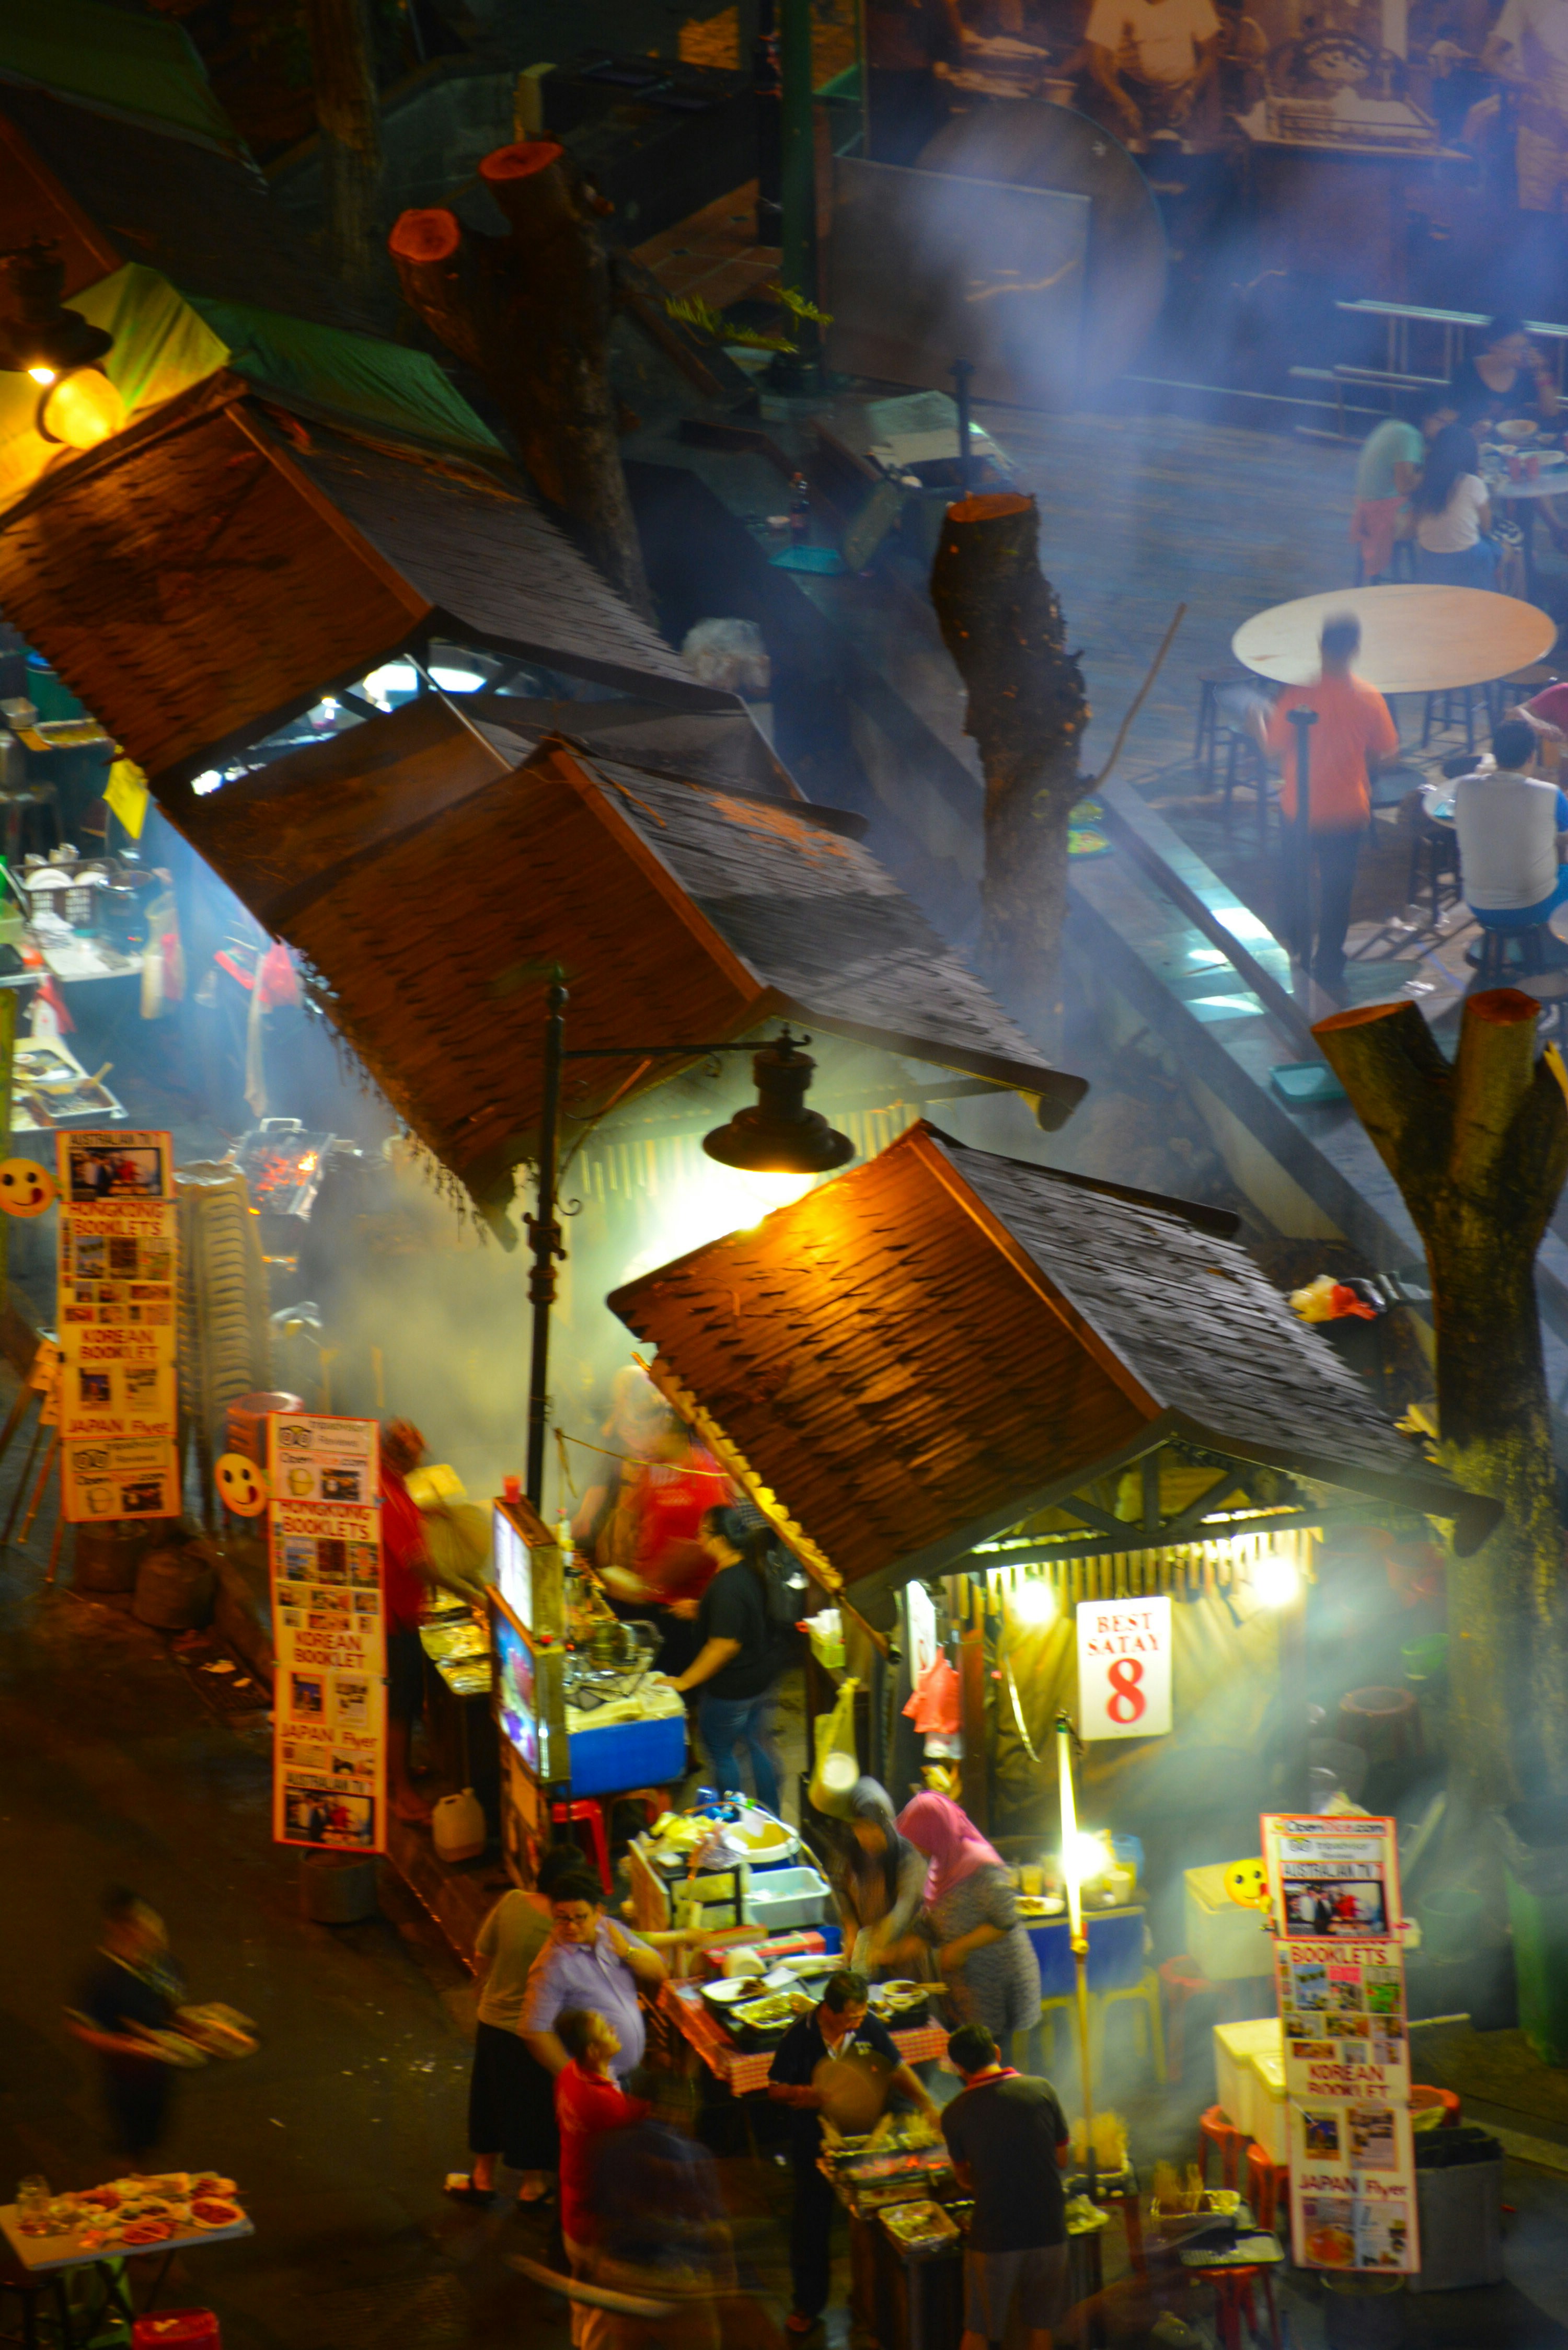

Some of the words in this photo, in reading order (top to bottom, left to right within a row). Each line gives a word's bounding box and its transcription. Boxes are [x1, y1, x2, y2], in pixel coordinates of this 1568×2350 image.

[70, 1203, 164, 1218] HONGKONG
[74, 1218, 162, 1237] BOOKLETS
[82, 1329, 154, 1344] KOREAN
[79, 1343, 159, 1359] BOOKLET
[67, 1419, 124, 1433] JAPAN
[132, 1420, 169, 1435] Flyer
[279, 1502, 371, 1522] HONGKONG
[282, 1515, 370, 1540] BOOKLETS
[1097, 1612, 1153, 1633] BEST
[294, 1630, 363, 1652] KOREAN
[1087, 1633, 1162, 1656] SATAY
[293, 1648, 367, 1669] BOOKLET
[1106, 1657, 1147, 1724] 8
[280, 1723, 335, 1743] JAPAN
[341, 1731, 377, 1749] Flyer
[1284, 1863, 1354, 1877] AUSTRALIAN
[1290, 1945, 1388, 1965] BOOKLETS
[1309, 2065, 1385, 2081] KOREAN
[1307, 2080, 1390, 2098] BOOKLET
[1298, 2174, 1359, 2193] JAPAN
[1364, 2178, 1408, 2201] Flyer
